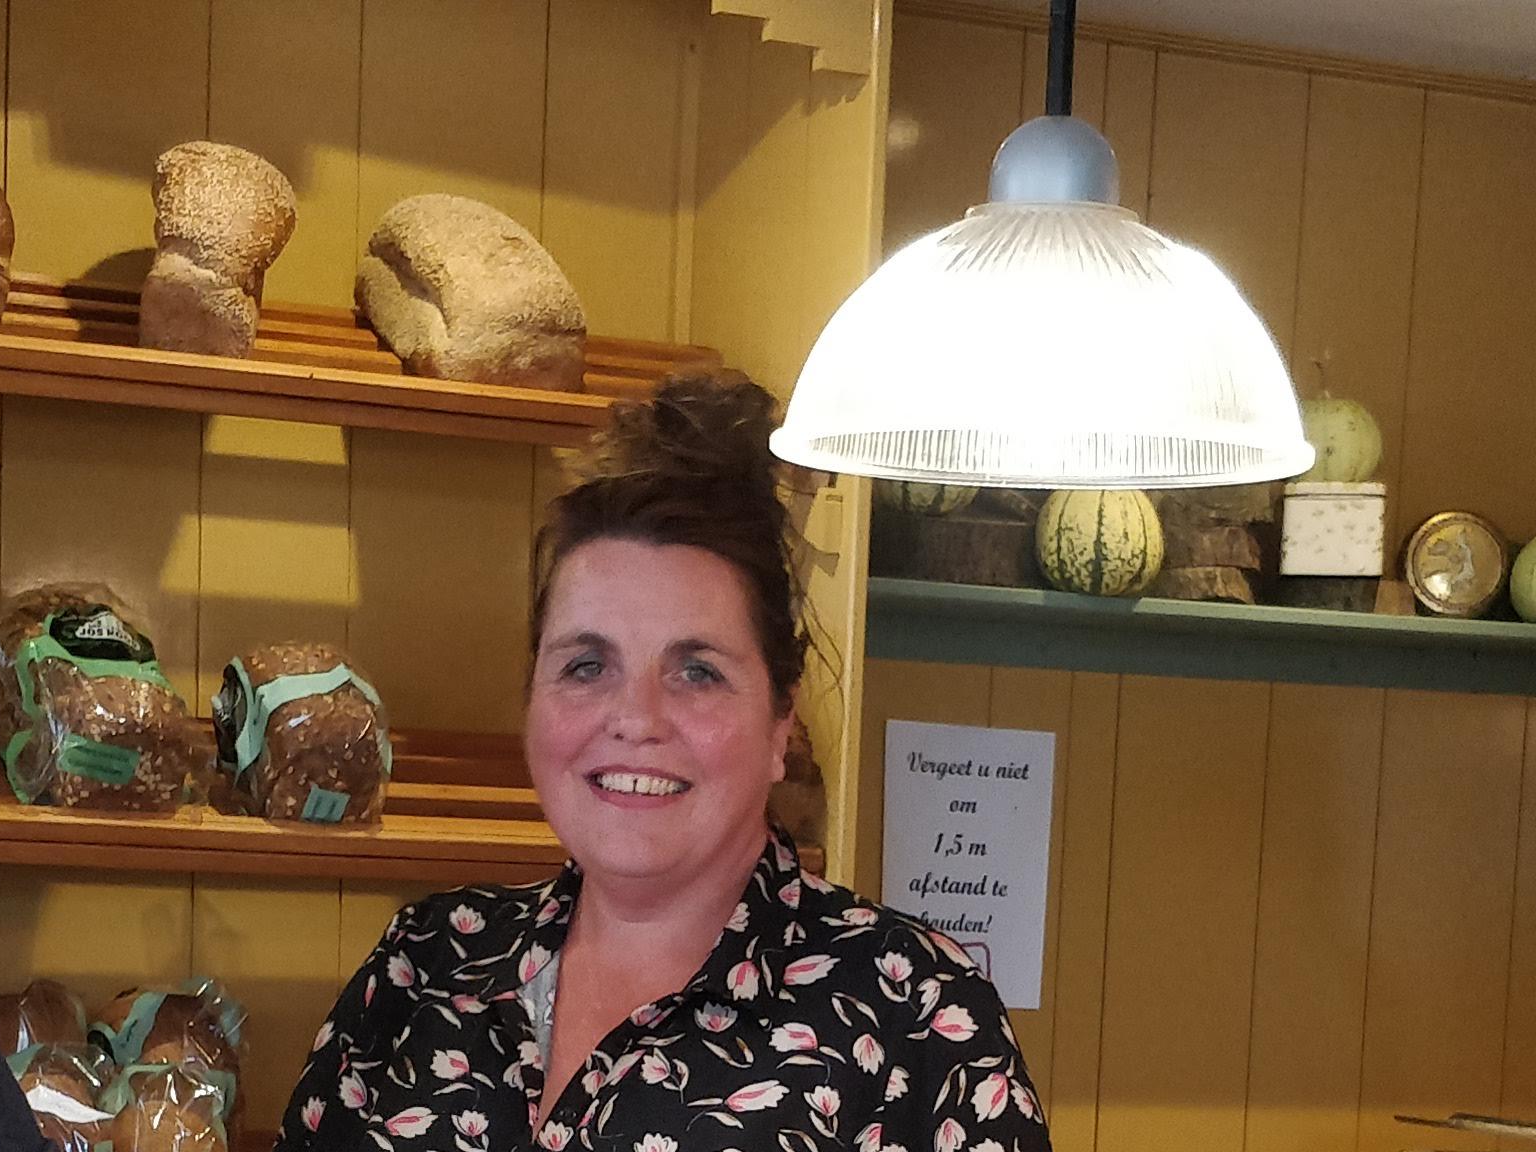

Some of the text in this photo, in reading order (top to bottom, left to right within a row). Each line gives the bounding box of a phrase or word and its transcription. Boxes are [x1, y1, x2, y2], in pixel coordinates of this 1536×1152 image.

[907, 752, 1030, 780] Vergeet u niet
[949, 800, 978, 813] om
[934, 833, 987, 857] 1,5 m
[909, 872, 1009, 898] afstand te
